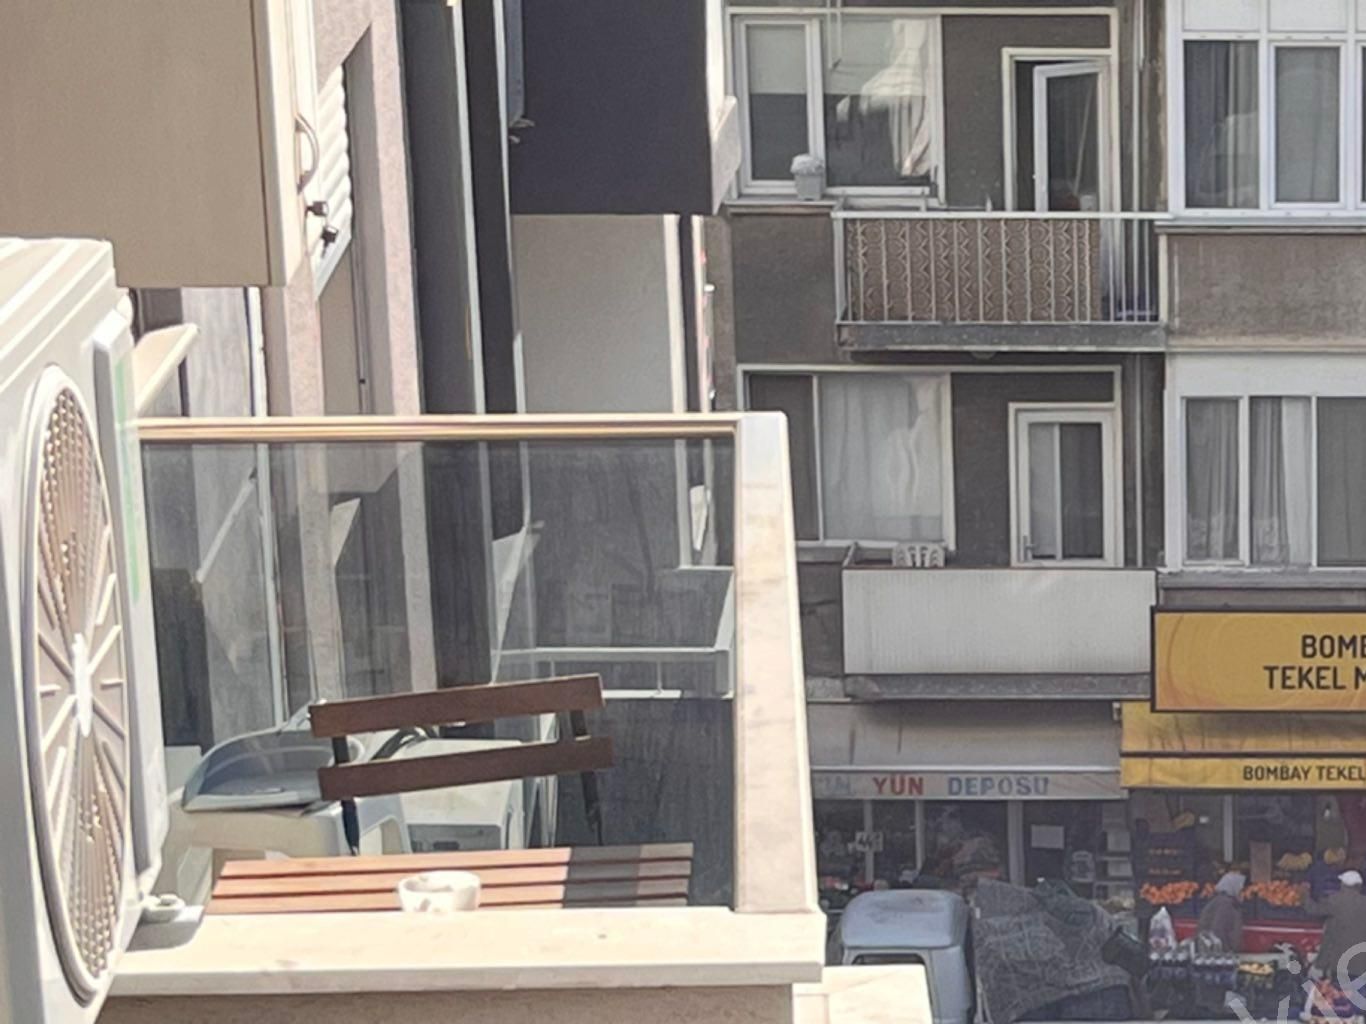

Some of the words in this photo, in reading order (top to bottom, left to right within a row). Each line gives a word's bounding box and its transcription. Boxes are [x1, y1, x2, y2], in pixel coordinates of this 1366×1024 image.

[1263, 666, 1346, 690] TEKEL
[1243, 766, 1312, 782] BOMBAY
[1316, 766, 1366, 782] TEKEL
[947, 777, 1050, 797] DEPOSU
